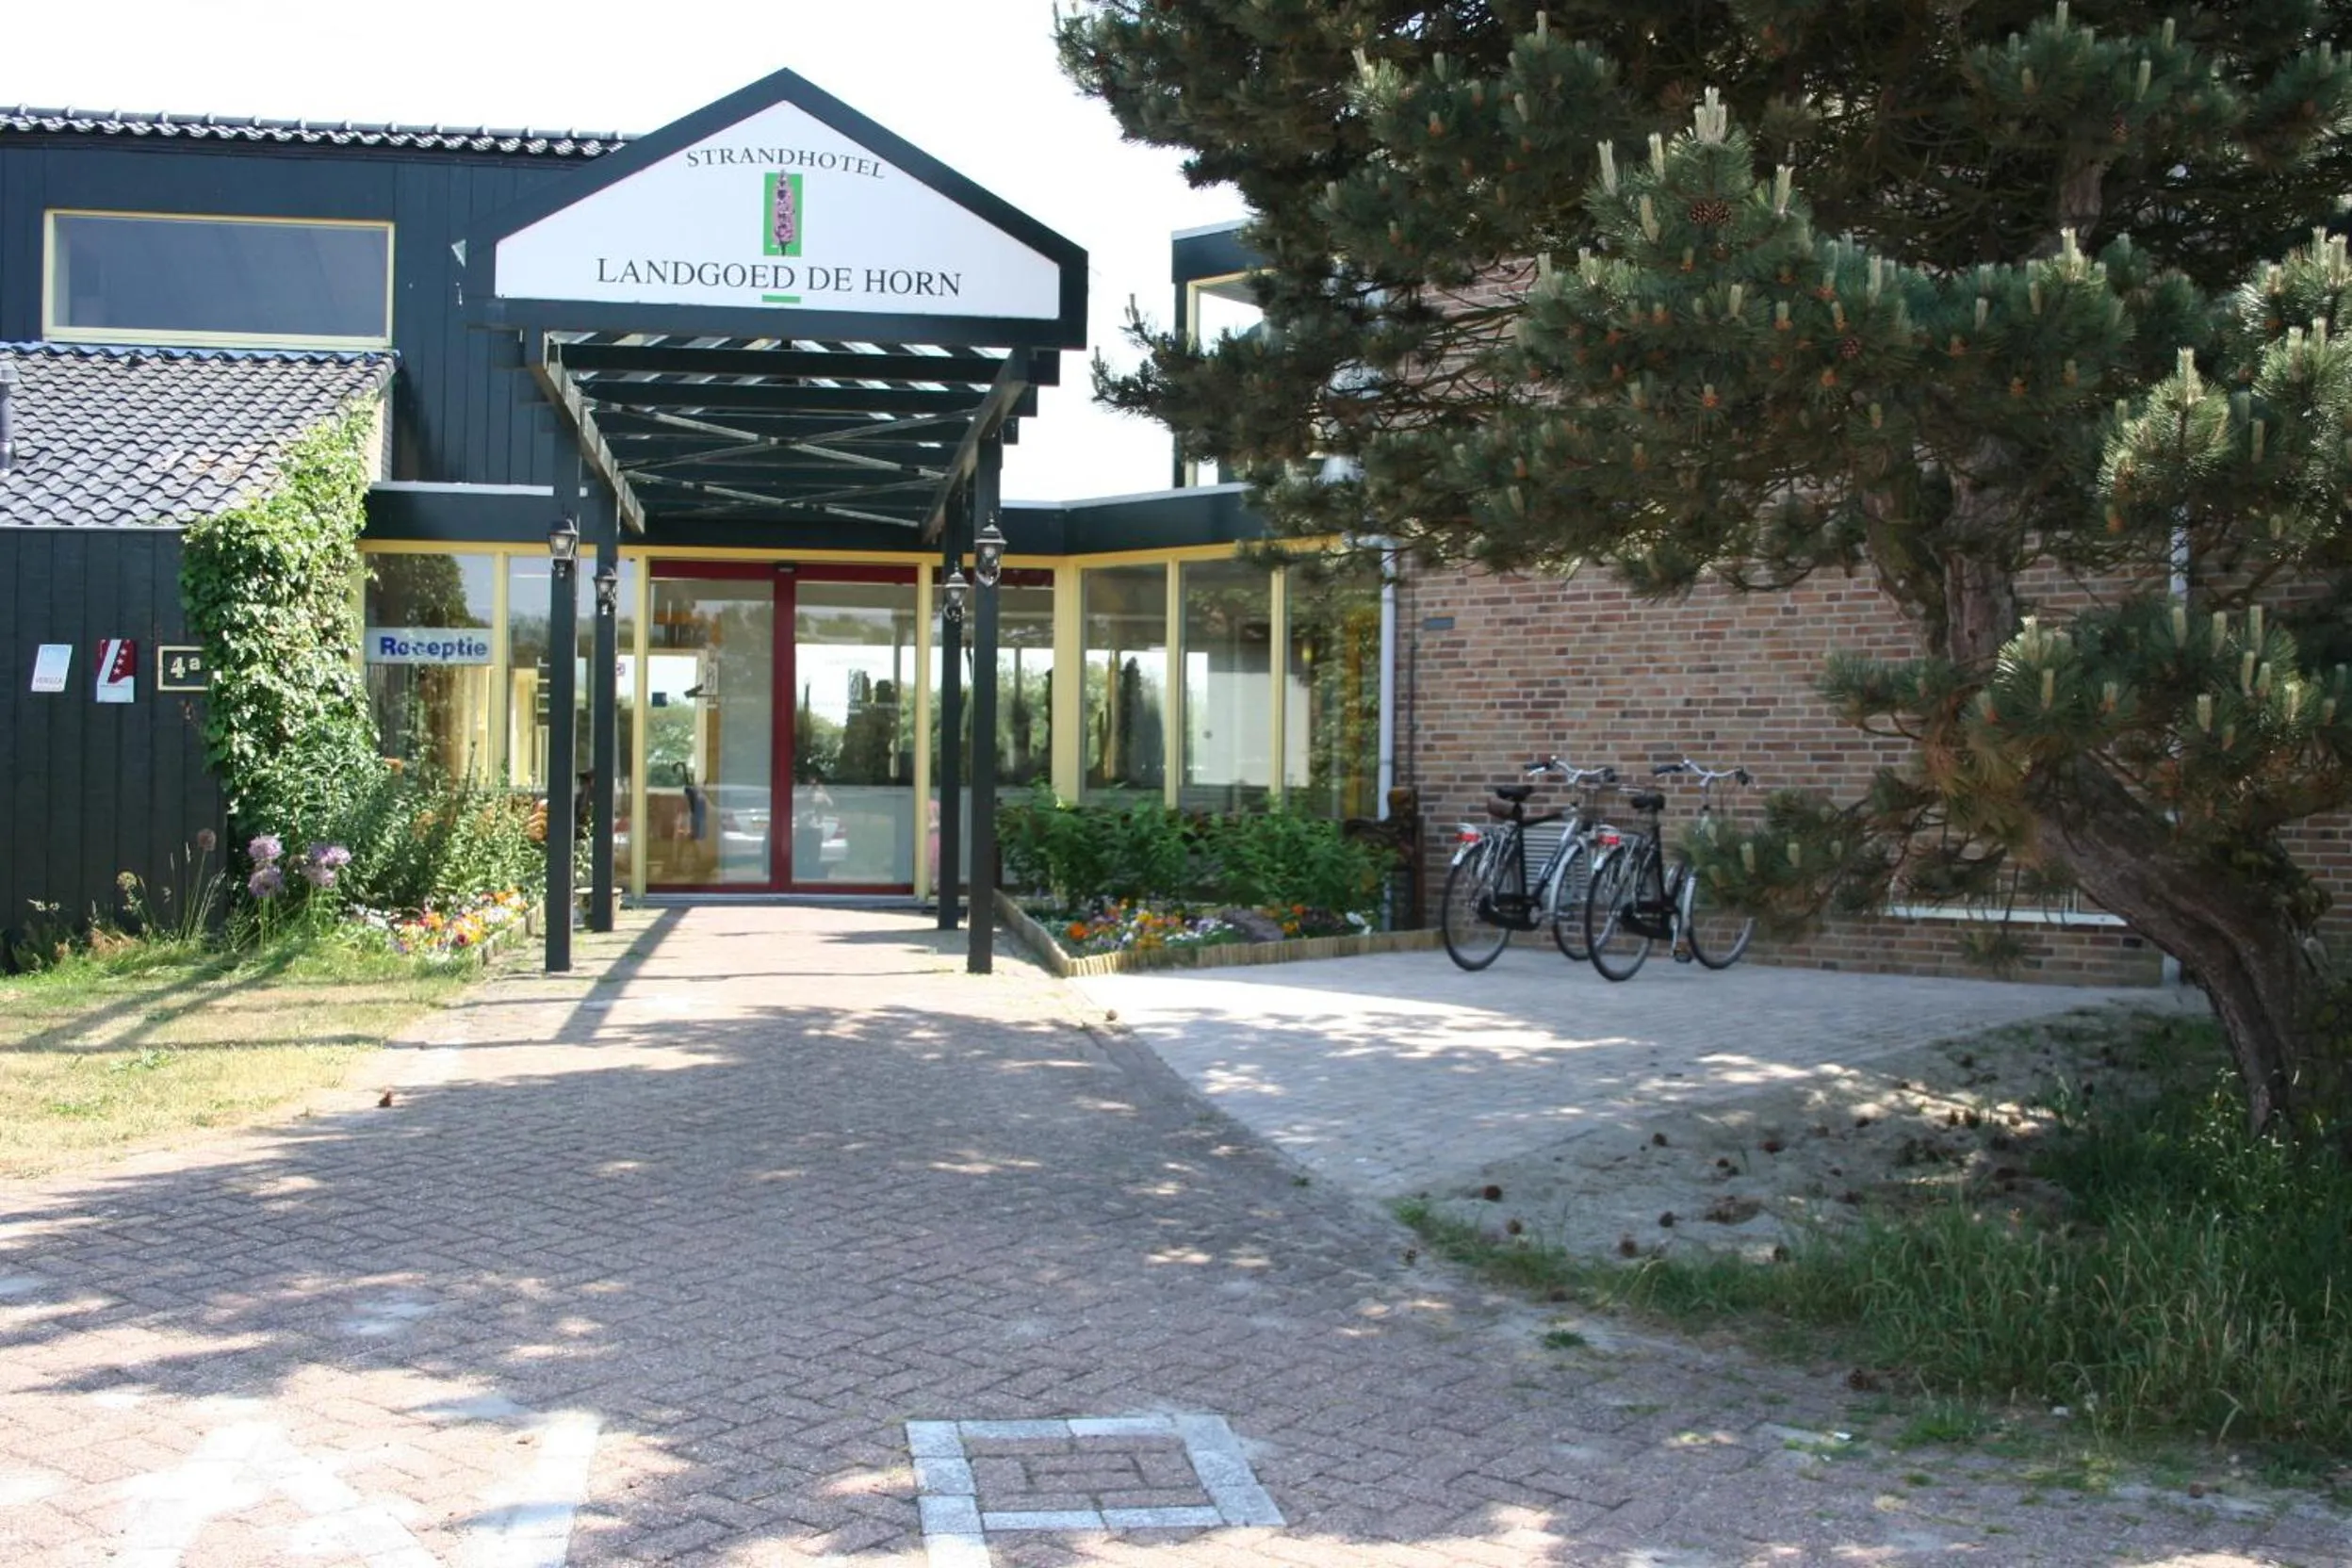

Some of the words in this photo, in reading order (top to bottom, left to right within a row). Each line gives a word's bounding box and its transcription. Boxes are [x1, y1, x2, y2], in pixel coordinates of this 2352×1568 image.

[686, 147, 886, 179] STRANDHOTEL
[596, 258, 795, 289] LANDGOED
[808, 266, 854, 292] DE
[865, 269, 962, 297] HORN
[380, 636, 488, 661] Receptie
